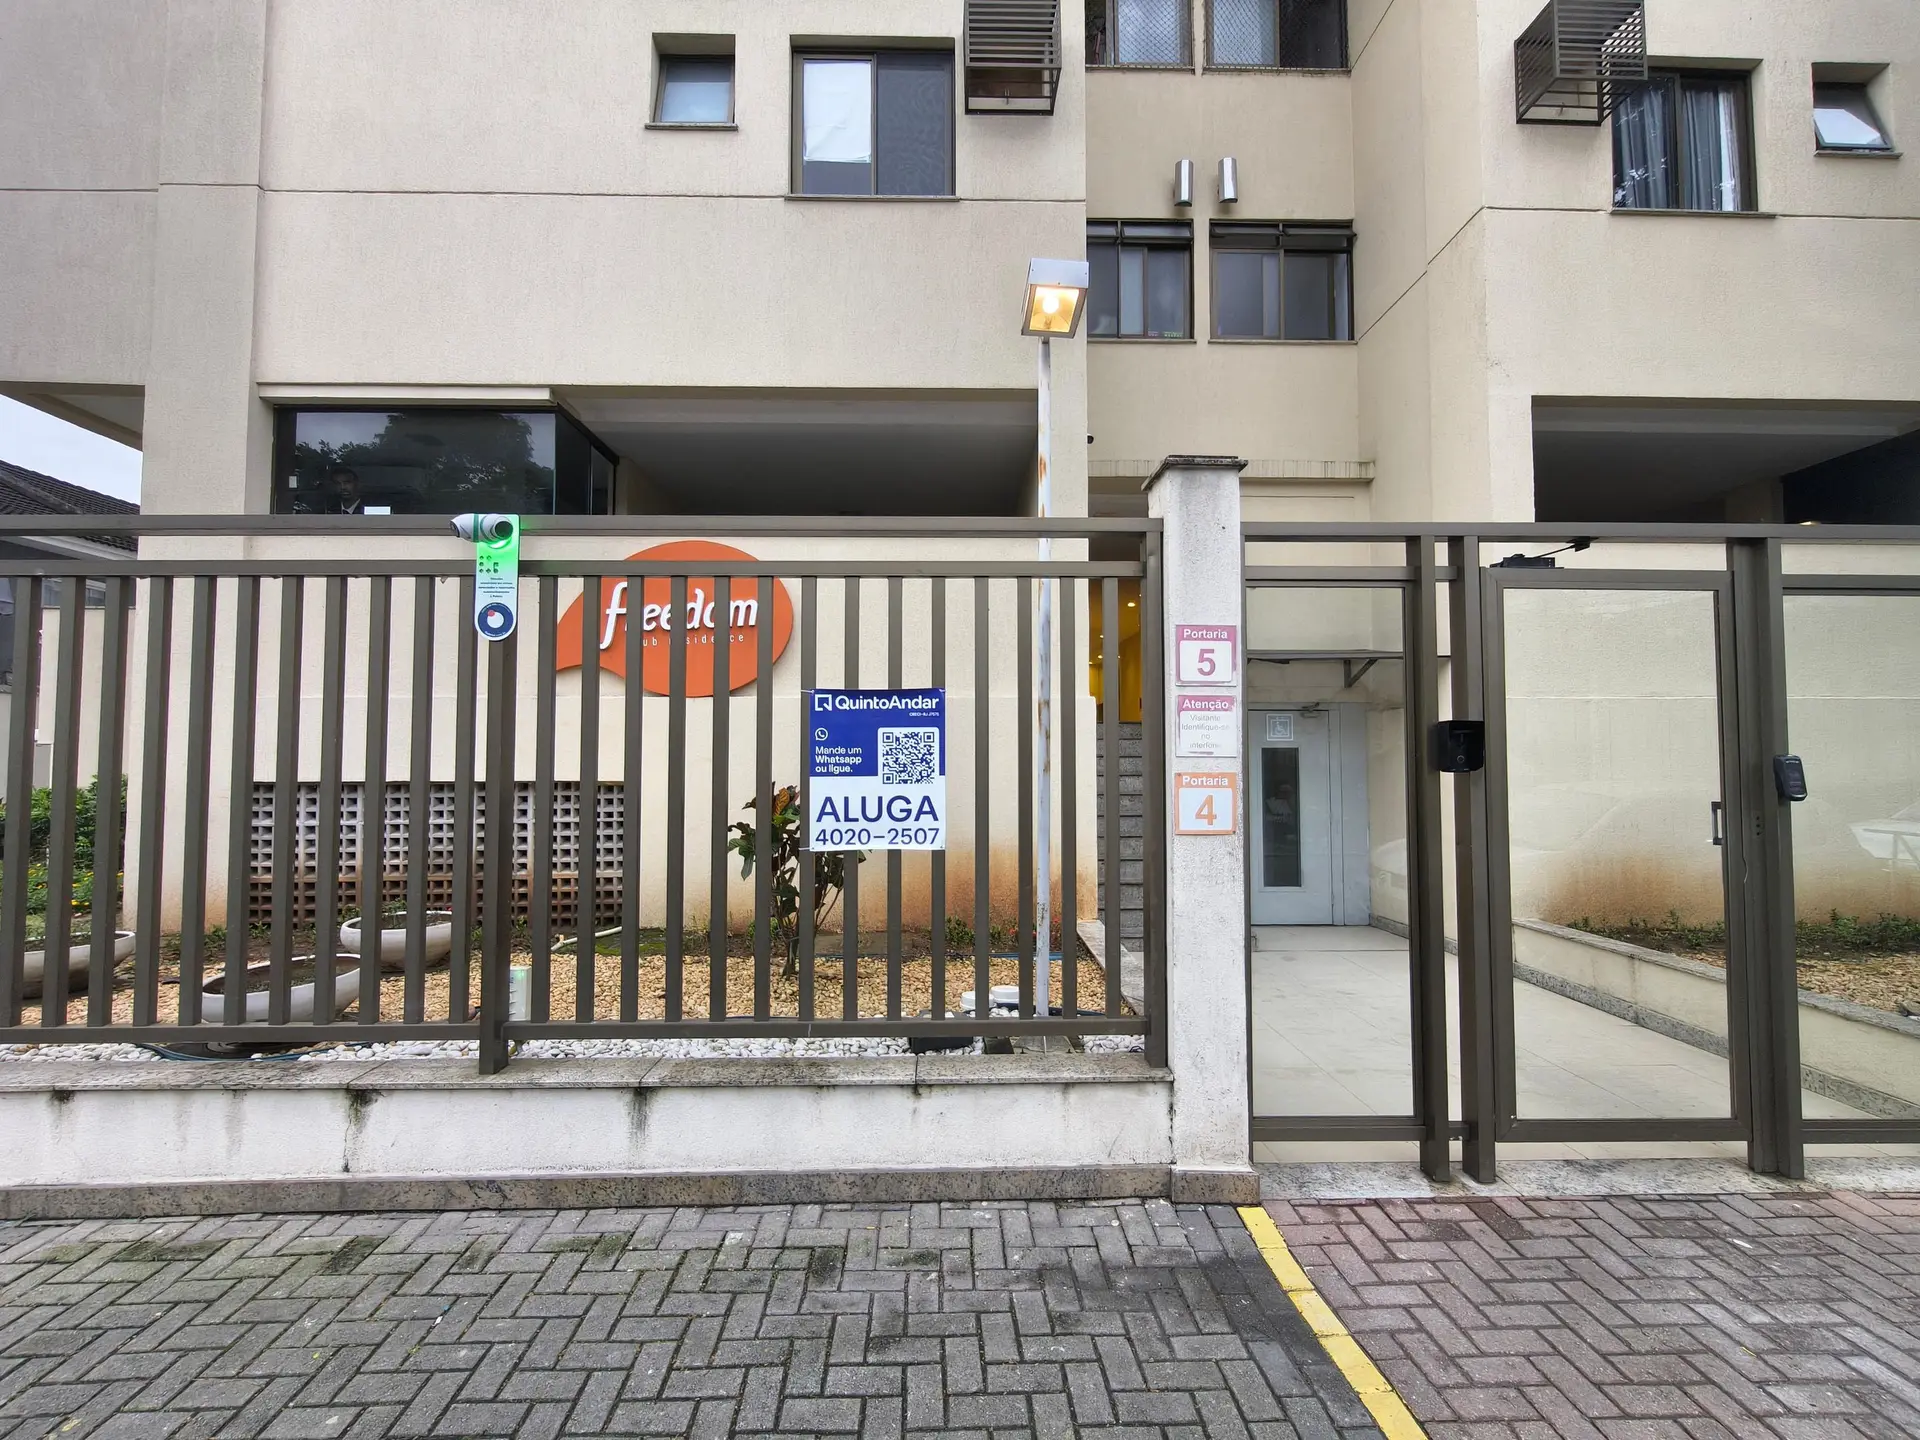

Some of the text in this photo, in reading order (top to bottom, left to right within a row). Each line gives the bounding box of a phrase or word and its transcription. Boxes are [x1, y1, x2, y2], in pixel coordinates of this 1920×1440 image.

[600, 581, 758, 650] feedom
[1183, 628, 1228, 639] Portaria
[1197, 648, 1216, 676] 5
[835, 695, 940, 710] QuintoAndar
[1182, 699, 1229, 711] Atenção
[1189, 714, 1221, 722] Visitante
[815, 746, 862, 755] Mande um
[815, 755, 862, 765] Whatsapp
[815, 764, 853, 774] ou ligue.
[1182, 776, 1229, 786] Portaria
[816, 795, 939, 823] ALUGA
[1195, 794, 1217, 826] 4
[815, 828, 940, 845] 4020-2507
